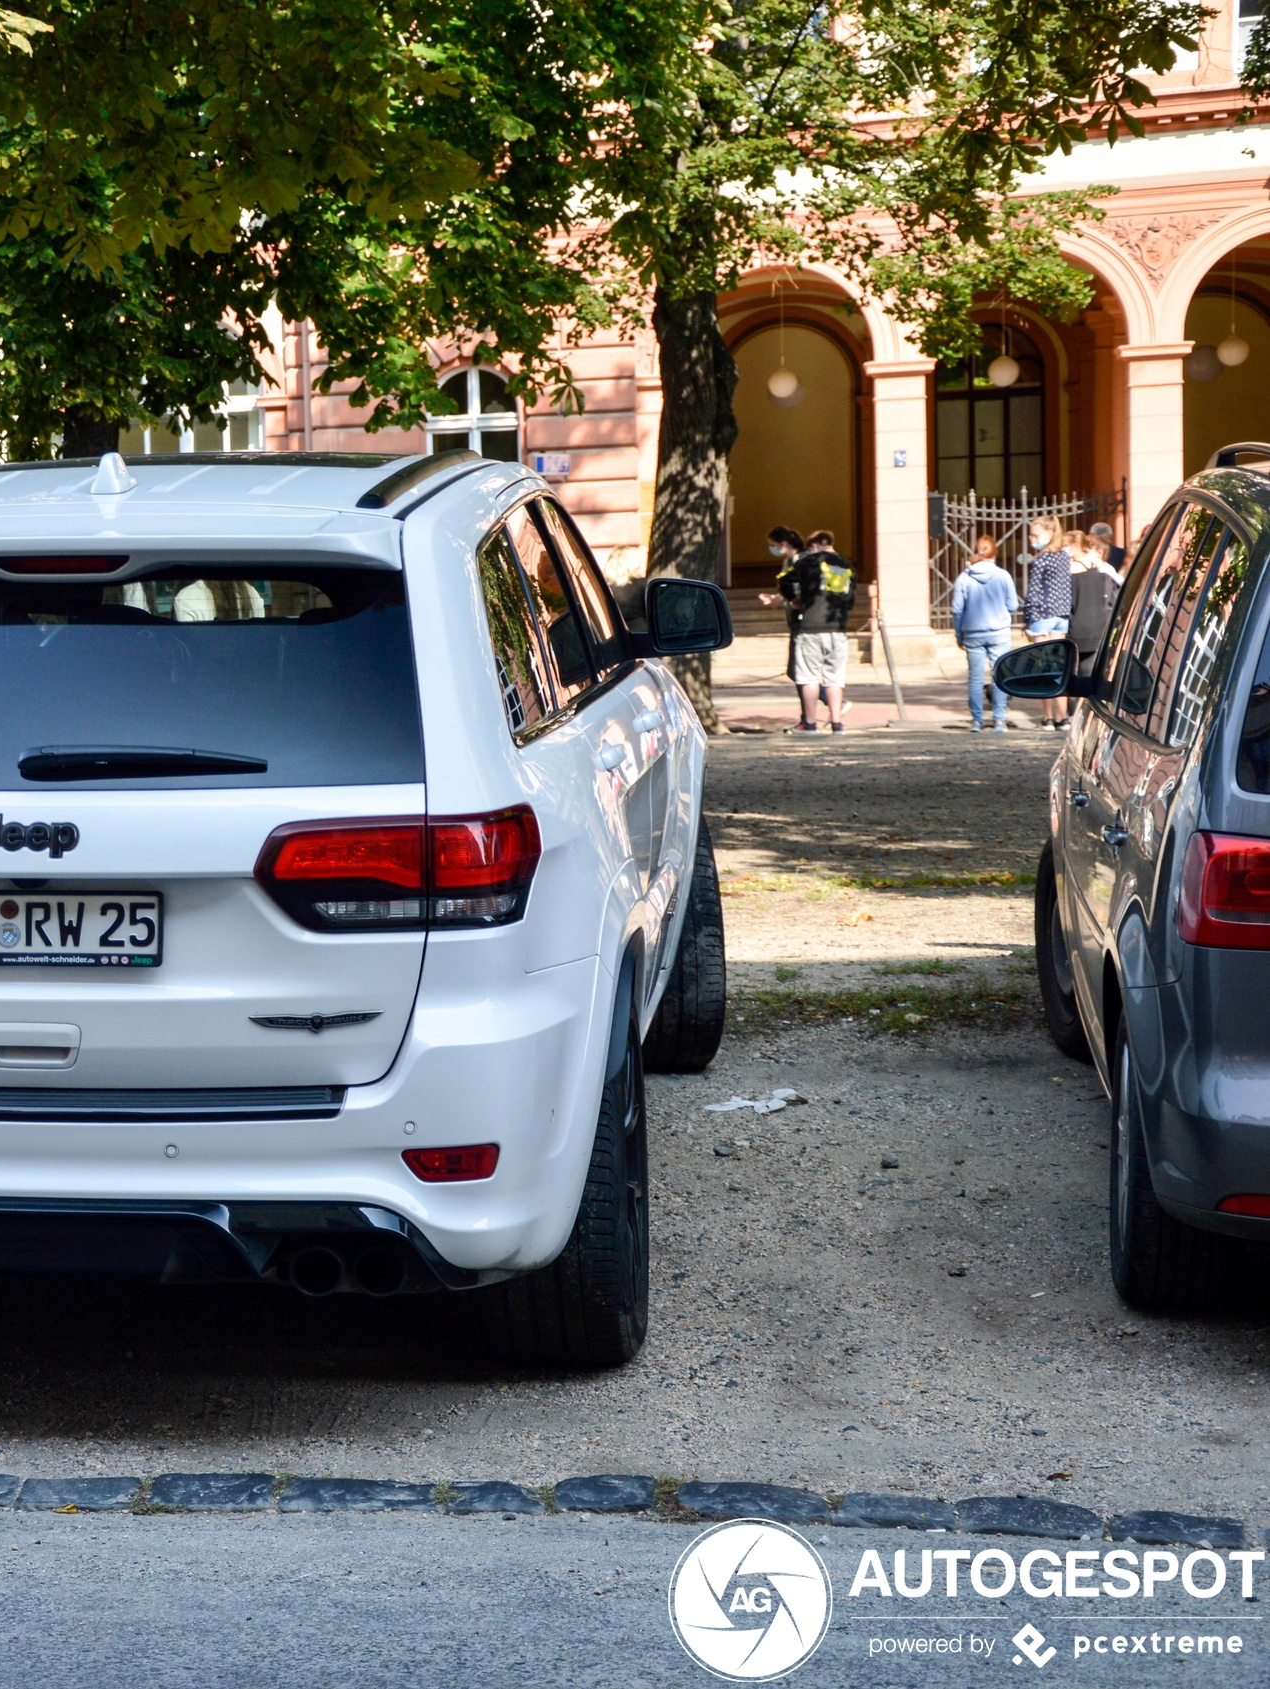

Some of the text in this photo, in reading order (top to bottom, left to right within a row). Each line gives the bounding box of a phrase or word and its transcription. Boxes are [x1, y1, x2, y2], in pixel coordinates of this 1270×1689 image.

[25, 901, 85, 947] RW
[99, 902, 156, 947] 25
[2, 956, 95, 964] www.autowelt-schneider.de
[131, 956, 153, 965] Jeep
